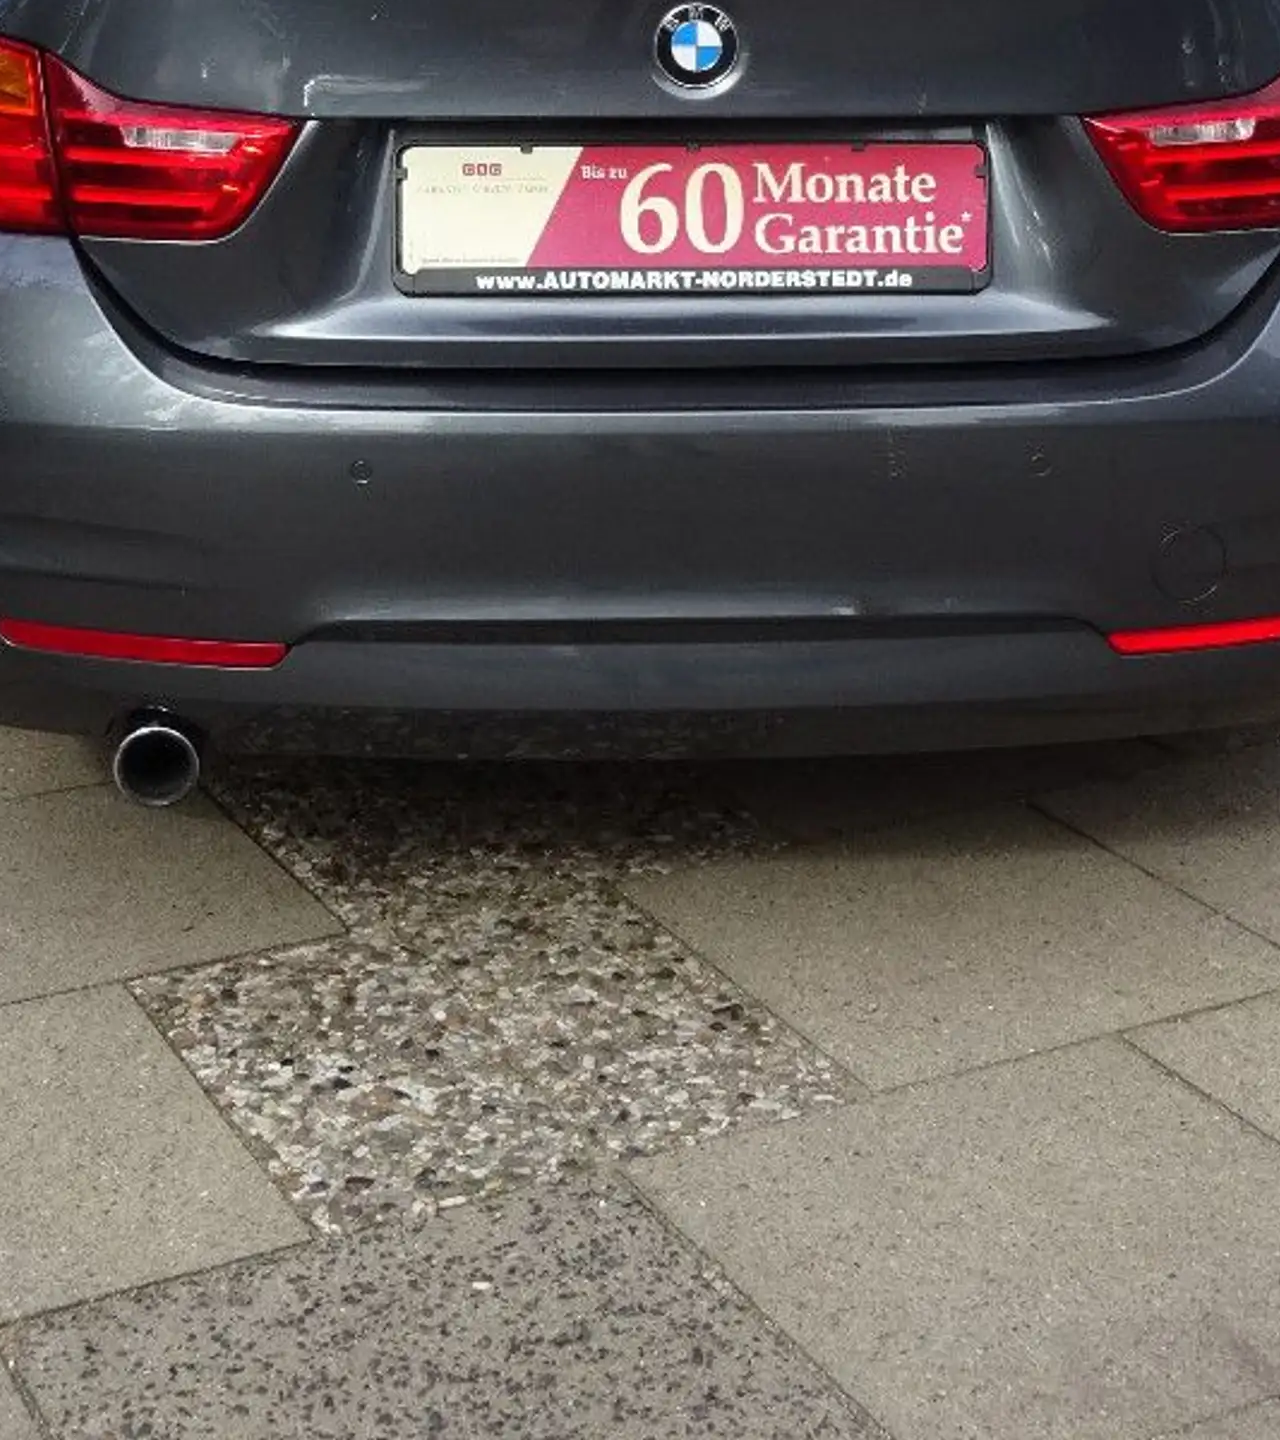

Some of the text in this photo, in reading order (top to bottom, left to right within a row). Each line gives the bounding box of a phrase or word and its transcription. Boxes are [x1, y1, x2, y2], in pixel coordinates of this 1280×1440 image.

[621, 162, 744, 254] 60
[752, 162, 937, 203] Monate
[476, 270, 913, 290] www.AUTOMARKT-NORDERSTEDT.de
